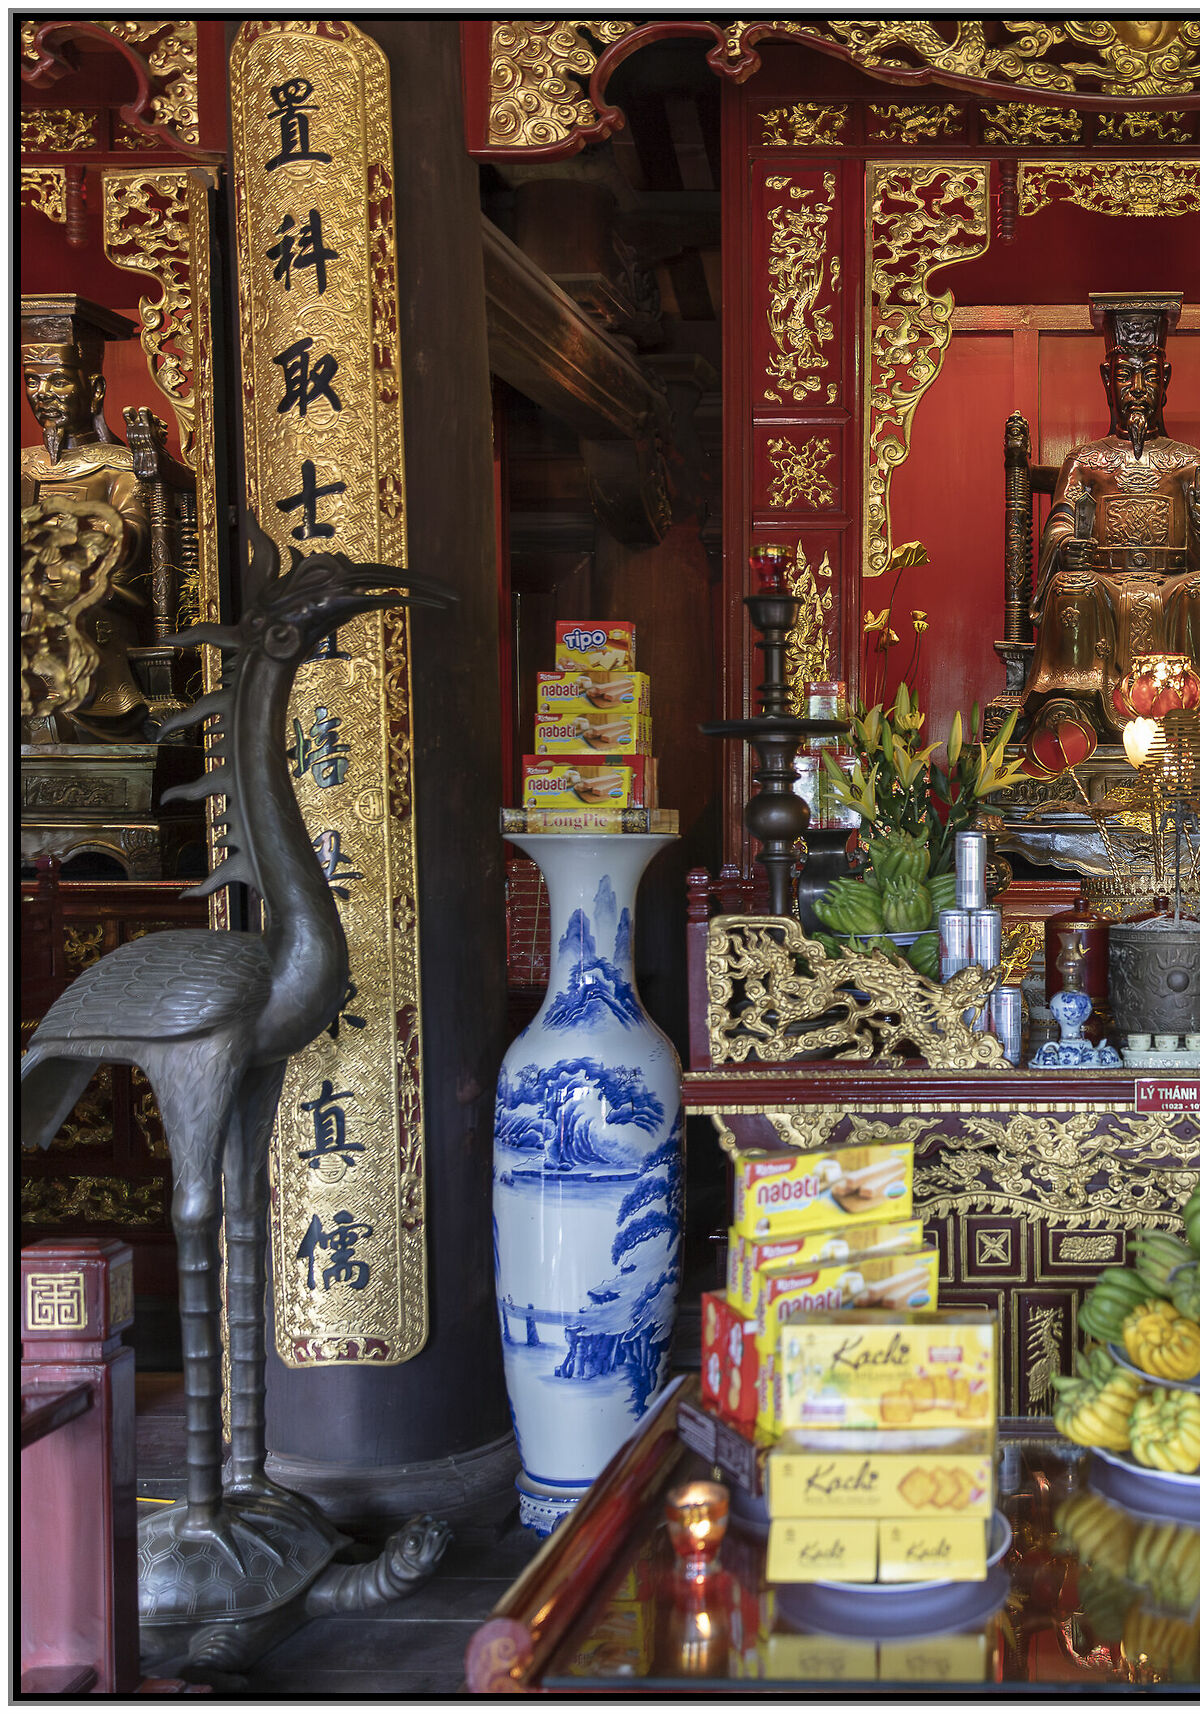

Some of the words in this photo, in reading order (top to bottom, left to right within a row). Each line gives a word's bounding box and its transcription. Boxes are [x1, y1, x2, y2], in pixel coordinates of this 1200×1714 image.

[541, 682, 580, 697] nabati
[538, 724, 577, 739] nabati
[528, 776, 567, 791] nabati
[1140, 1084, 1156, 1100] LÝ
[1157, 1084, 1198, 1100] THÁNH
[756, 1177, 819, 1206] nabati
[832, 1332, 911, 1370] Kachi
[804, 1459, 880, 1495] Kachi
